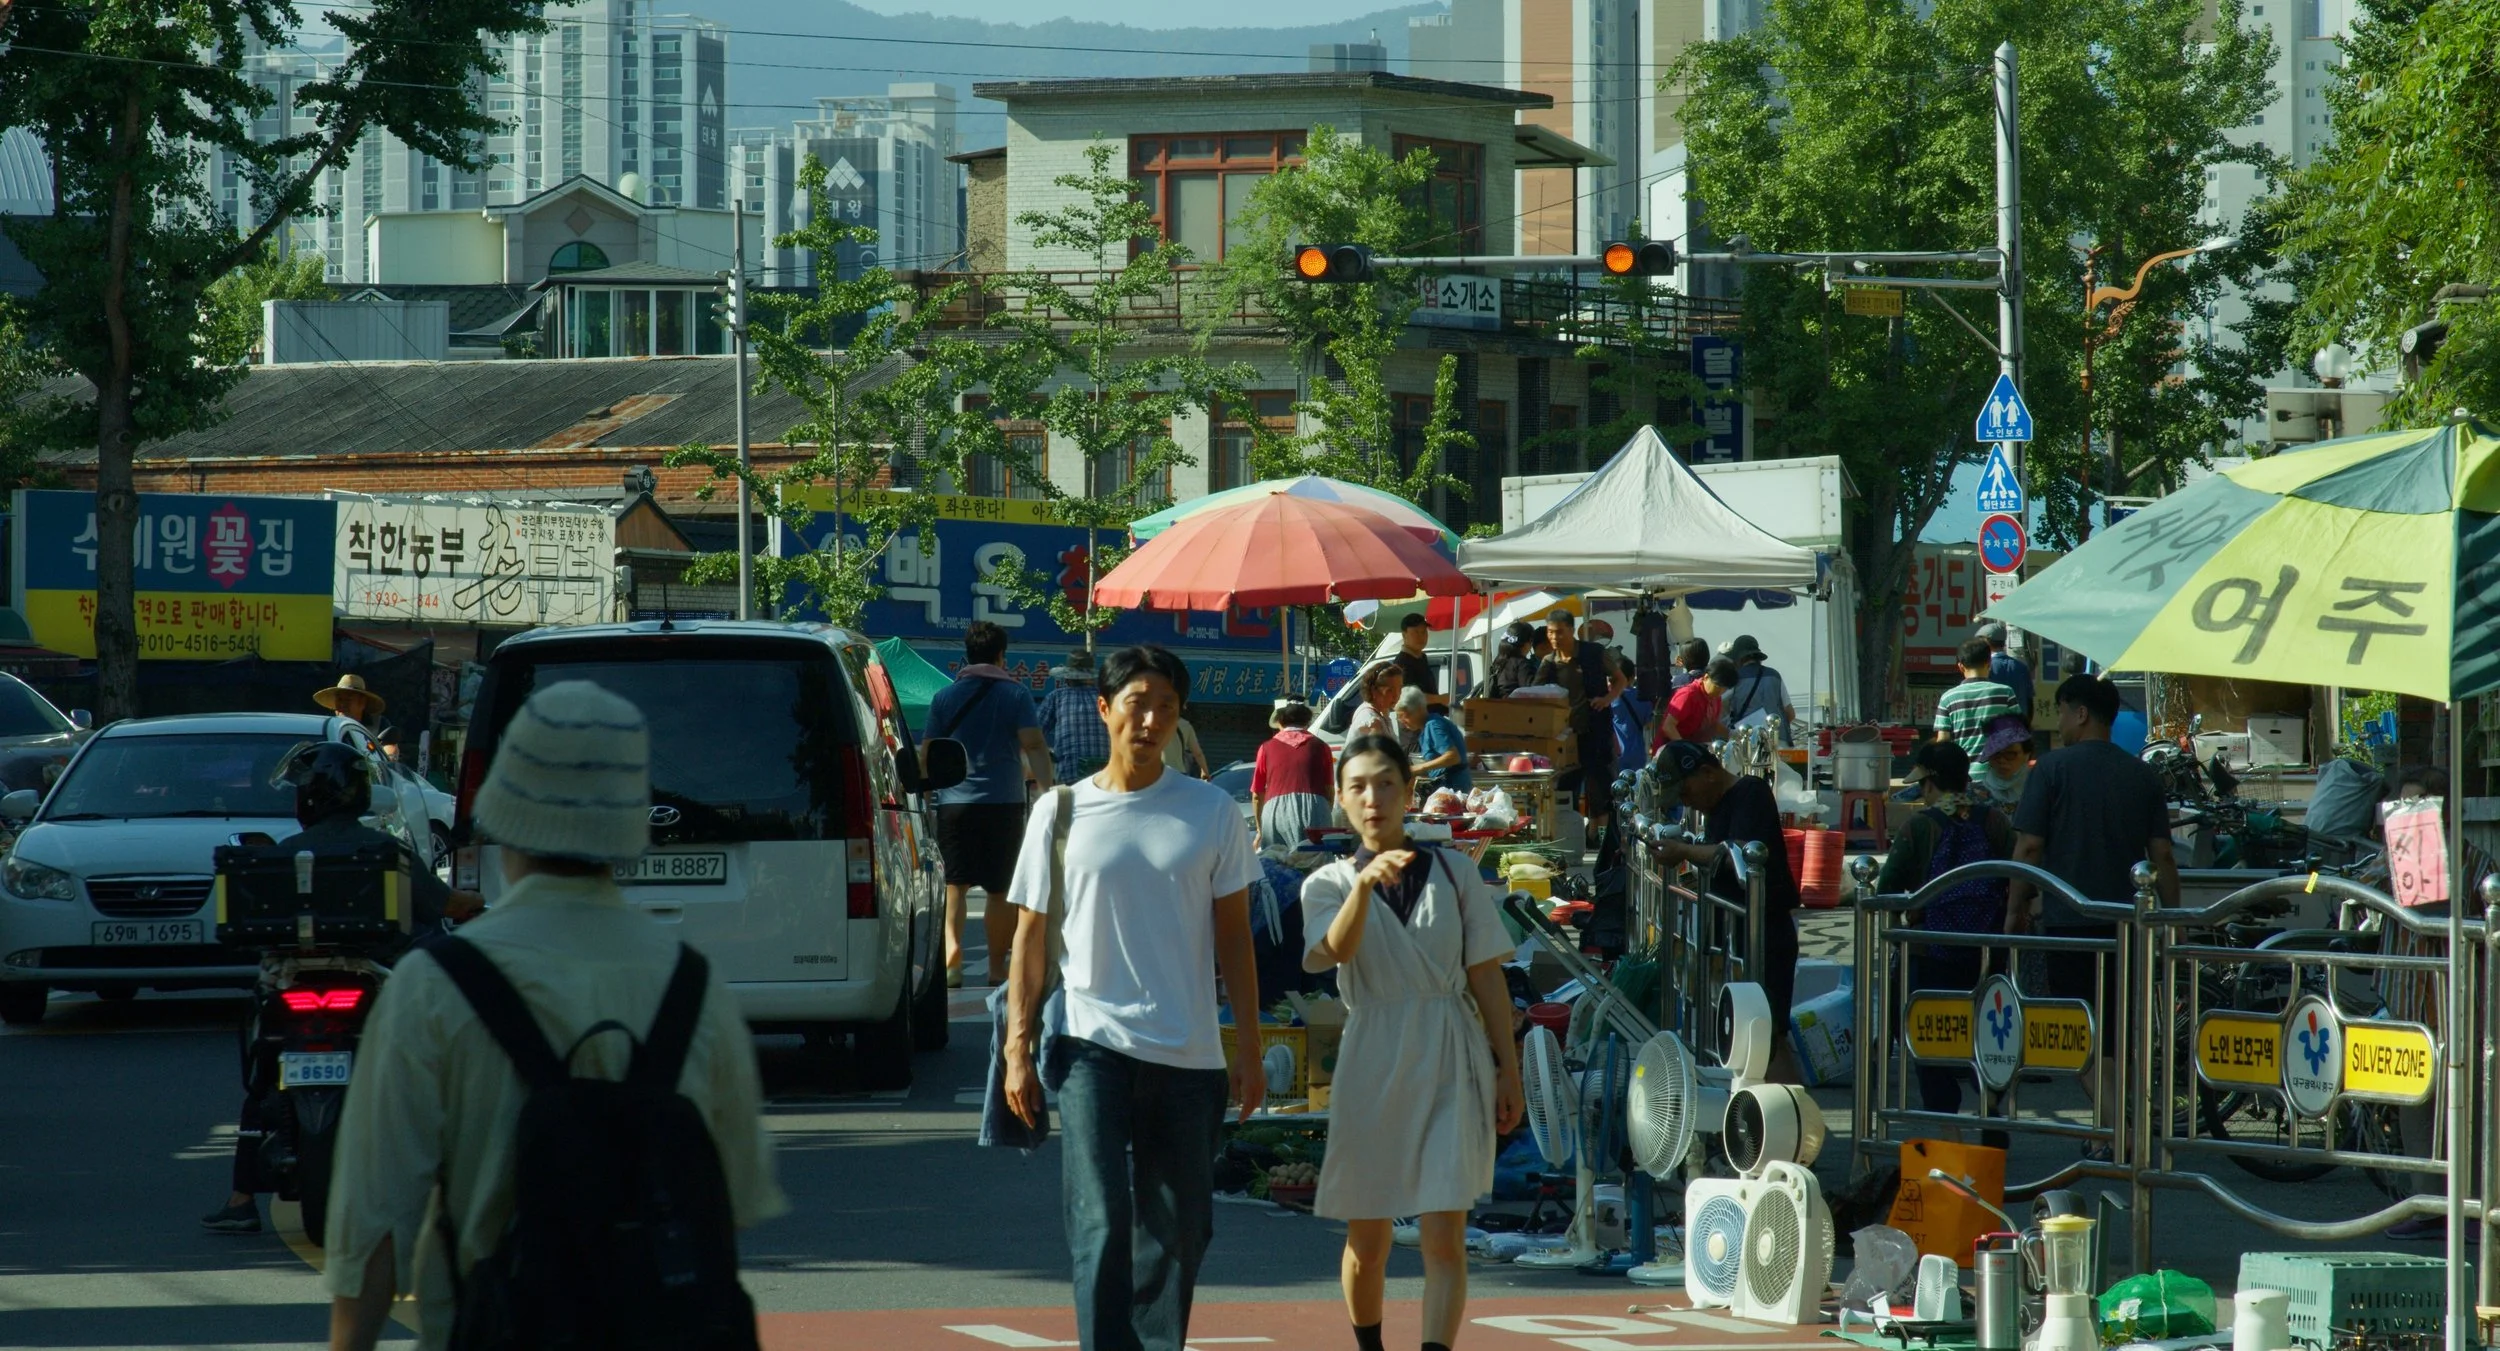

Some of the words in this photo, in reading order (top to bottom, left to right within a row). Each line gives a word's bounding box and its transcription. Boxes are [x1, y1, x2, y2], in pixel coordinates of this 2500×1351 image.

[1417, 277, 1496, 312] 업소개소
[1985, 428, 2024, 438] 노인보호
[945, 497, 1005, 520] 좌우한다!
[1983, 499, 2016, 511] 횡단보도
[590, 517, 605, 530] 수상
[521, 527, 555, 542] 대구시장
[588, 531, 605, 543] 수상
[1984, 538, 2019, 549] 주차금지
[349, 521, 465, 578] 착한농부
[885, 534, 1026, 627] 백운
[1991, 580, 2014, 589] 구간내
[133, 598, 183, 628] 격으로
[191, 597, 285, 631] 판매합니다.
[2190, 563, 2429, 666] 여주
[149, 634, 262, 651] 010-4516-5431
[1195, 664, 1230, 694] 개명,
[1234, 667, 1269, 695] 상호,
[671, 857, 720, 877] 8887
[147, 923, 193, 942] 1695
[1917, 1014, 1934, 1042] 노인
[1936, 1014, 1968, 1042] 보호구역
[2029, 1020, 2060, 1050] SILVER
[2062, 1024, 2087, 1052] ZONE
[2208, 1034, 2230, 1064] 노인
[2233, 1037, 2274, 1068] 보호구역
[2352, 1042, 2392, 1076] SILVER
[2394, 1047, 2426, 1079] ZONE
[302, 1065, 346, 1080] 8690
[2292, 1077, 2321, 1091] 대구광역시
[2321, 1080, 2334, 1093] 중구
